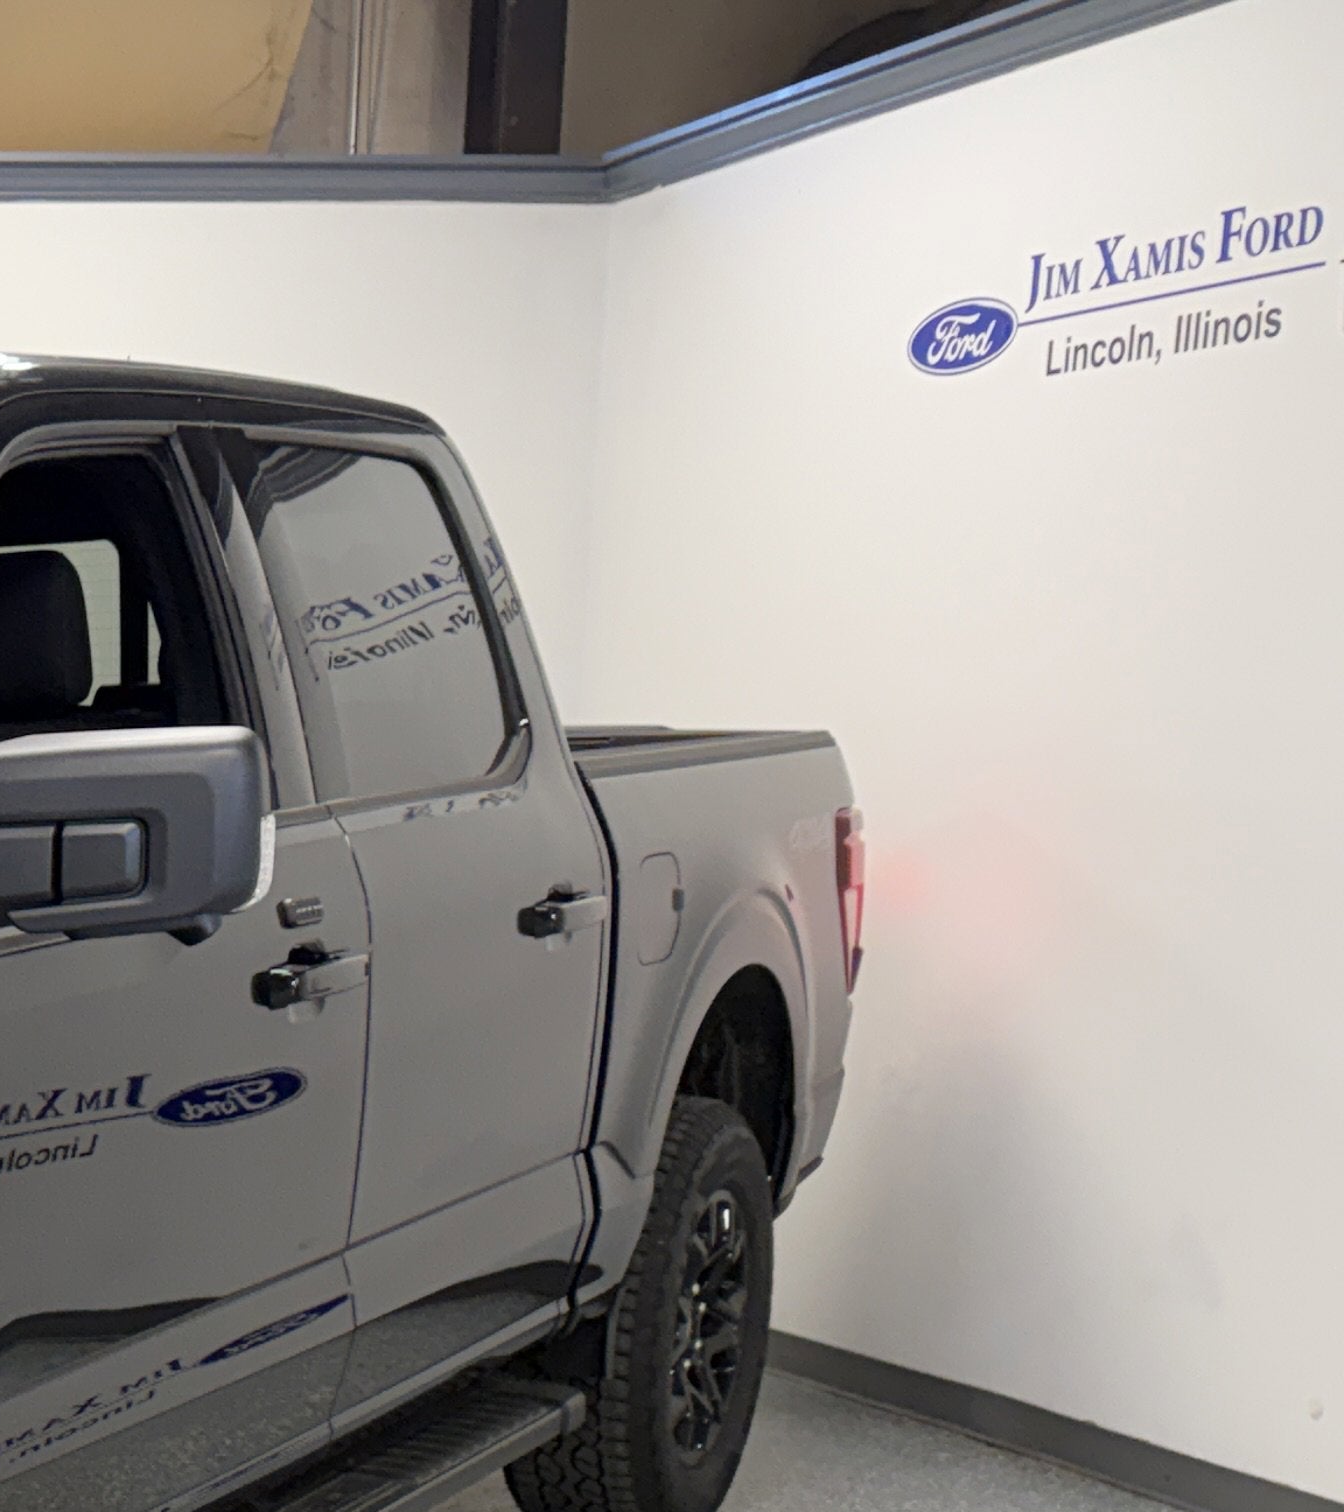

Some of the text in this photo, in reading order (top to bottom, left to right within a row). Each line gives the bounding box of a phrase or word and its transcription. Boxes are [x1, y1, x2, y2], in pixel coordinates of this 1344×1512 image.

[1024, 205, 1324, 314] JIM XAMIS FORD
[926, 312, 994, 365] Ford
[1045, 300, 1282, 377] Lincoln, Illinois
